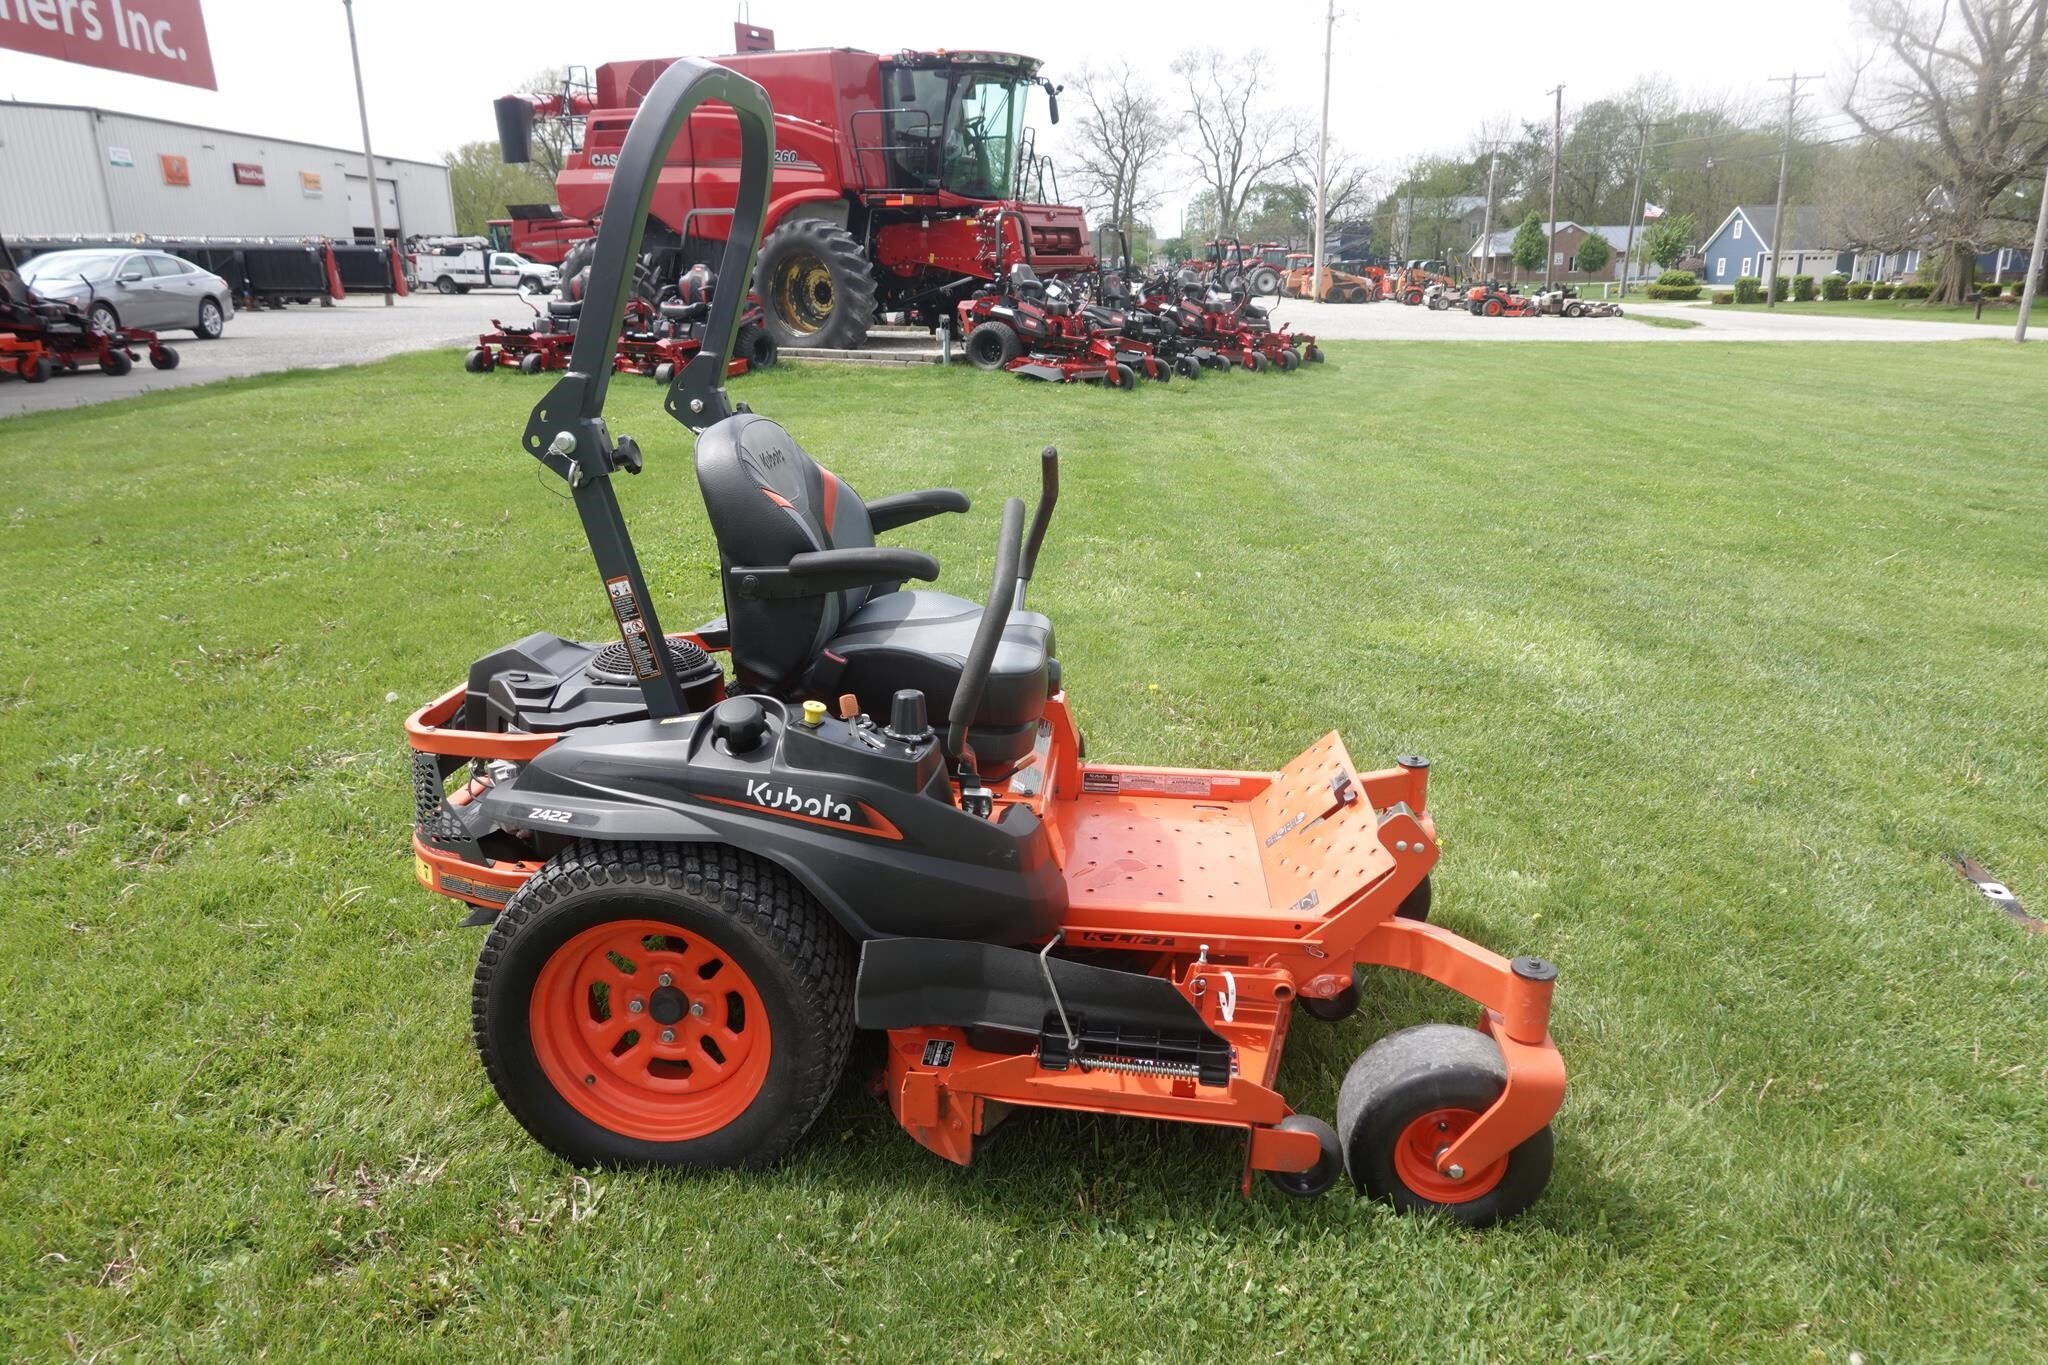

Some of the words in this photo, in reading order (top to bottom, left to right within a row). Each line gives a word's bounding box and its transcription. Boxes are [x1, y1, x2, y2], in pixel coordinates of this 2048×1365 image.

[111, 0, 188, 62] Inc.
[591, 153, 619, 167] CAS
[774, 149, 797, 163] 260
[759, 447, 785, 470] Kubota
[746, 779, 852, 822] Kubota
[527, 807, 572, 824] Z422
[1083, 931, 1175, 946] K-LIFT
